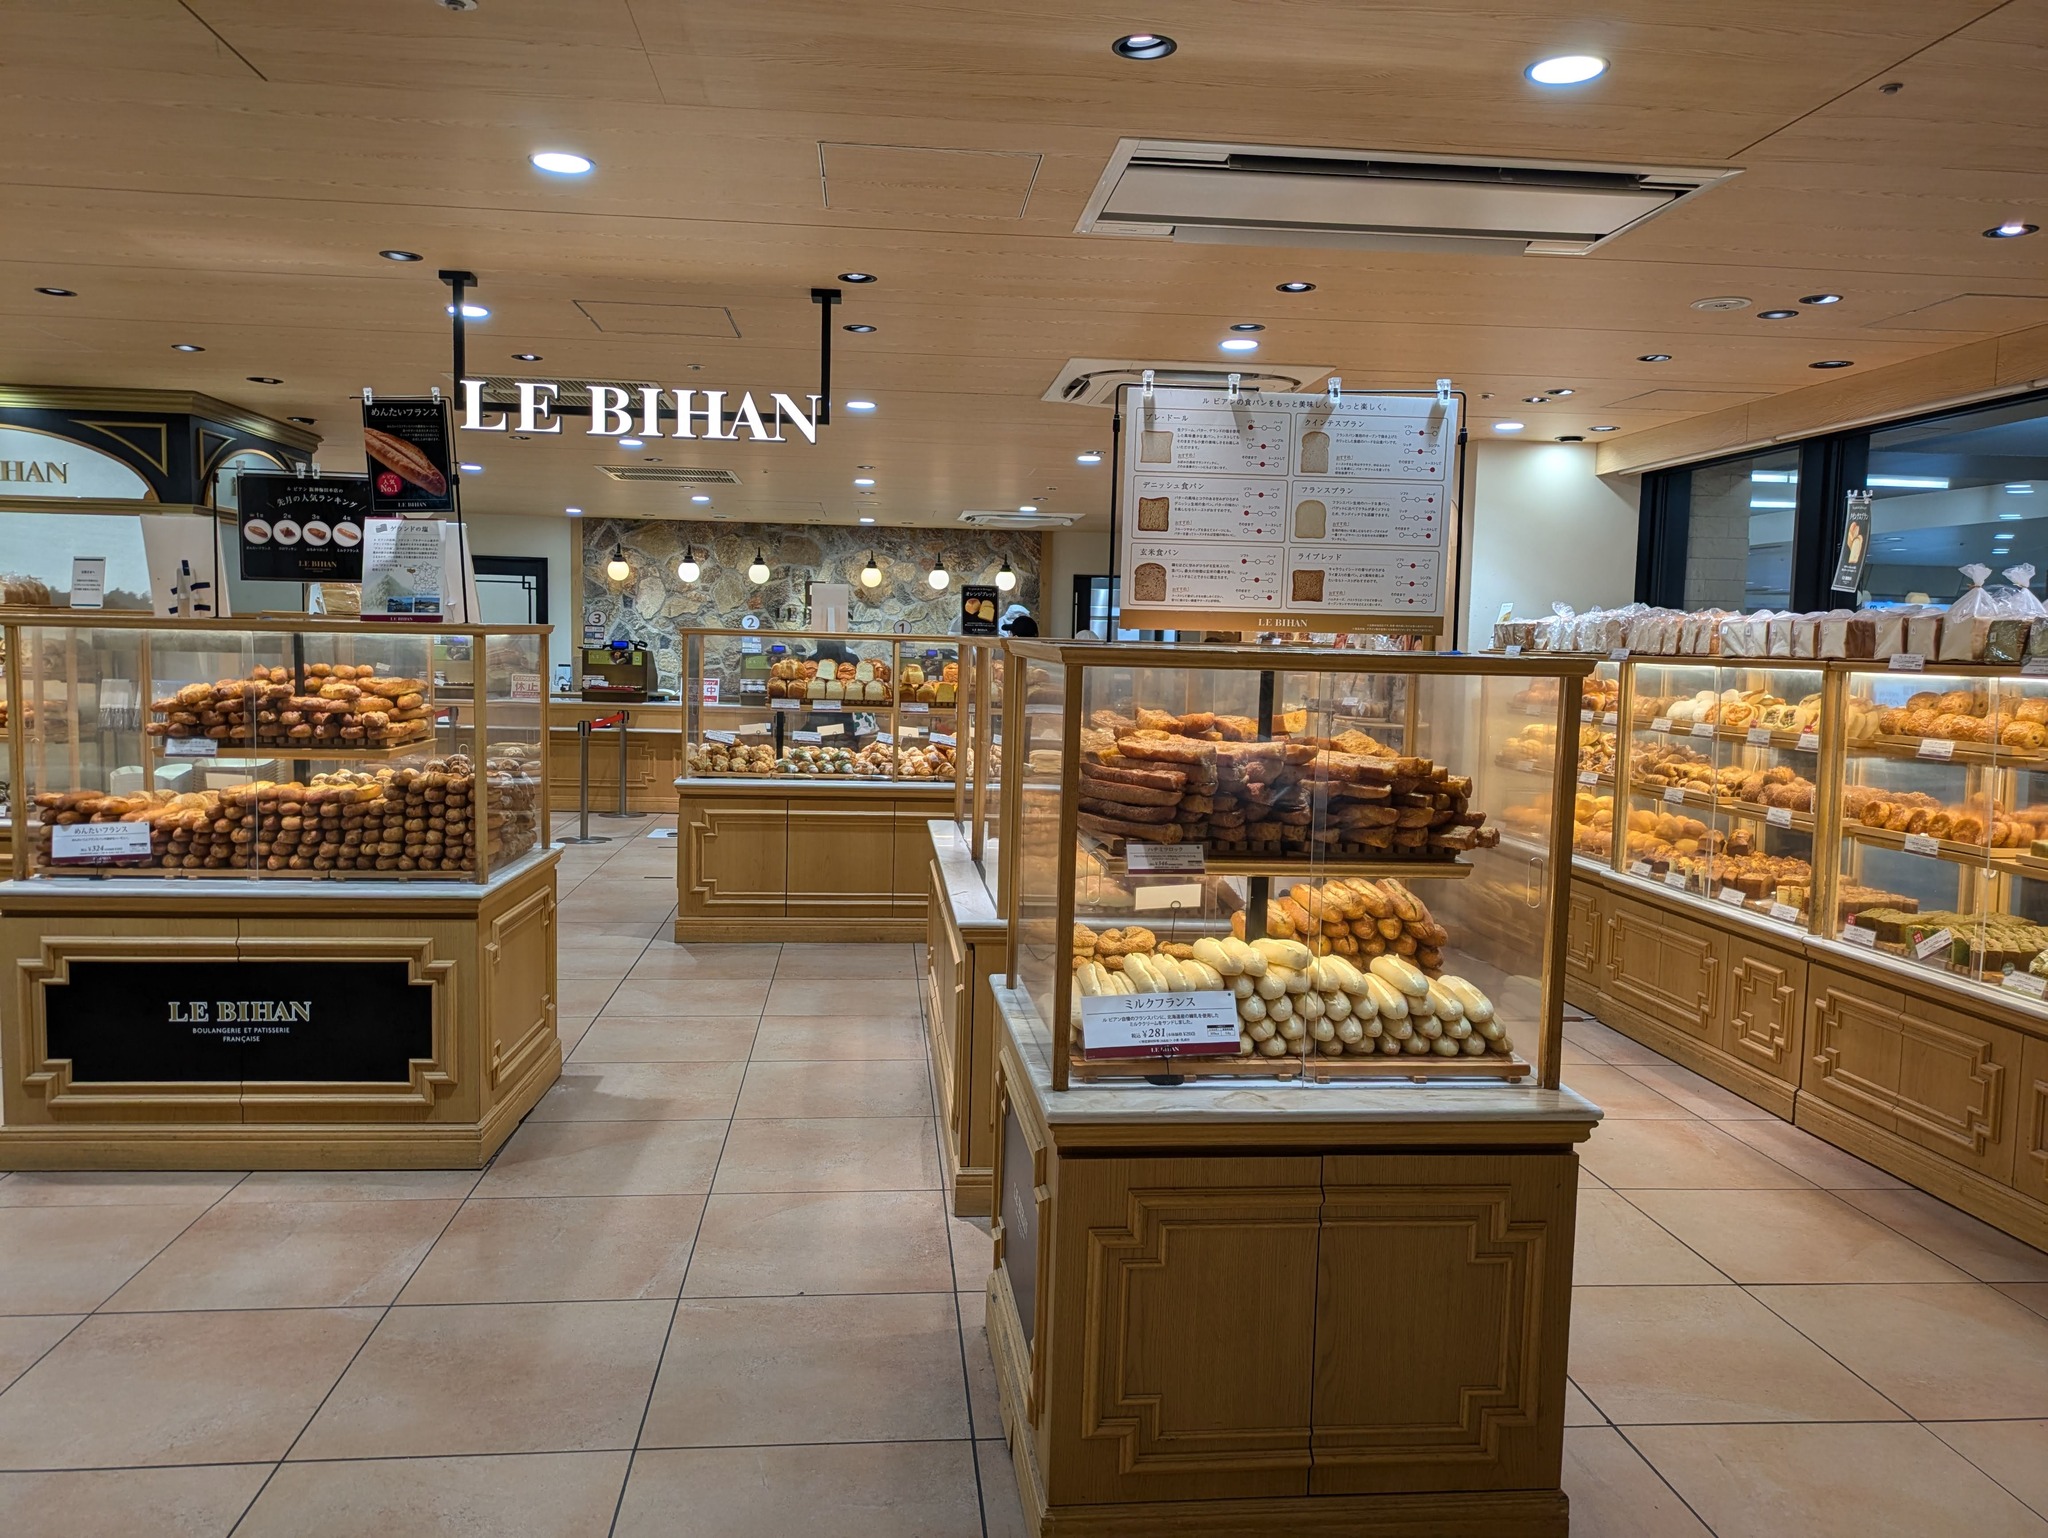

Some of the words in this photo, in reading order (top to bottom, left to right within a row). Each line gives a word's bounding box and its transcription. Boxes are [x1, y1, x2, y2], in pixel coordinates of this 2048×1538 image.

[370, 407, 438, 417] めんたいフランス
[460, 380, 562, 433] LE
[586, 385, 822, 444] BIHAN
[276, 494, 358, 508] 先月の人気ランキング
[1139, 548, 1179, 556] 玄米食パン
[1298, 553, 1342, 561] ライブレッド
[592, 614, 601, 624] 3
[746, 618, 755, 628] 2
[1258, 618, 1273, 626] LE
[1275, 619, 1308, 627] BIHAN
[899, 623, 905, 632] 1
[515, 682, 538, 691] 休止
[74, 826, 128, 834] めんたいフランス
[1125, 997, 1195, 1010] ミルクフランス
[168, 1001, 209, 1022] LE
[216, 1001, 312, 1022] BIHAN
[1142, 1028, 1165, 1038] ¥281
